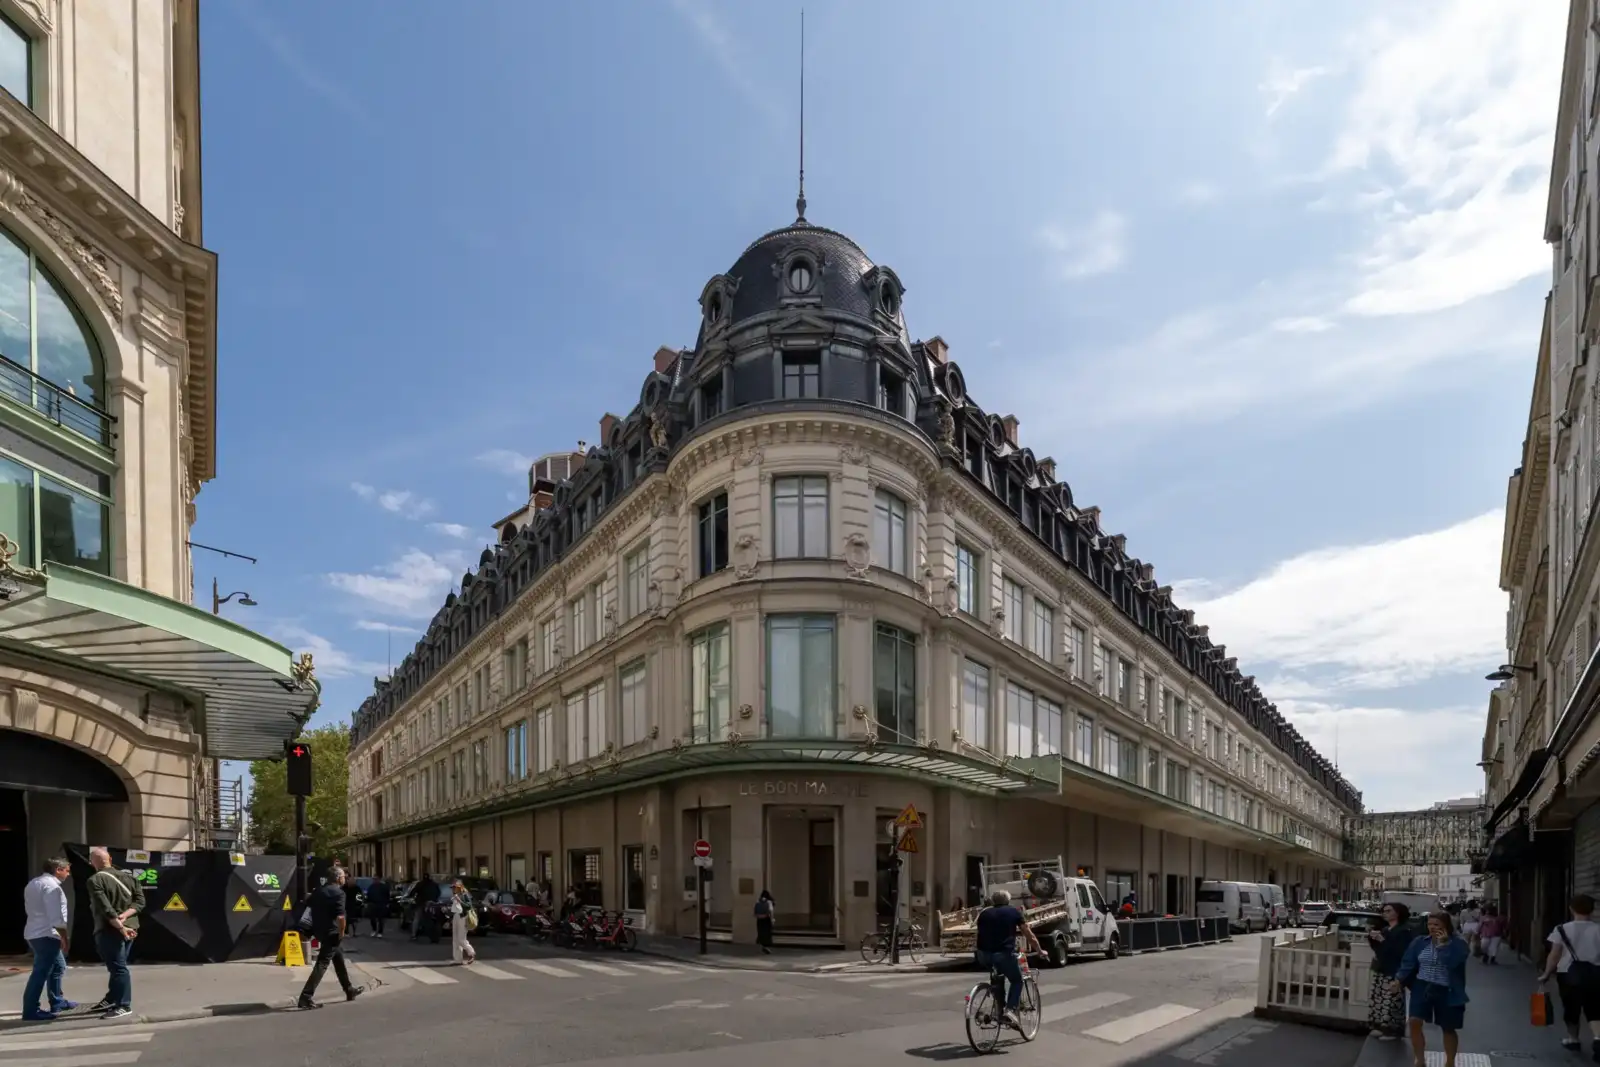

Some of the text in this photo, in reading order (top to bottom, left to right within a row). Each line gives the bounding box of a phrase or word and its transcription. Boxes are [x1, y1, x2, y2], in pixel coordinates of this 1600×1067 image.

[740, 782, 758, 797] LE
[764, 781, 799, 795] BON
[254, 873, 279, 885] GDS
